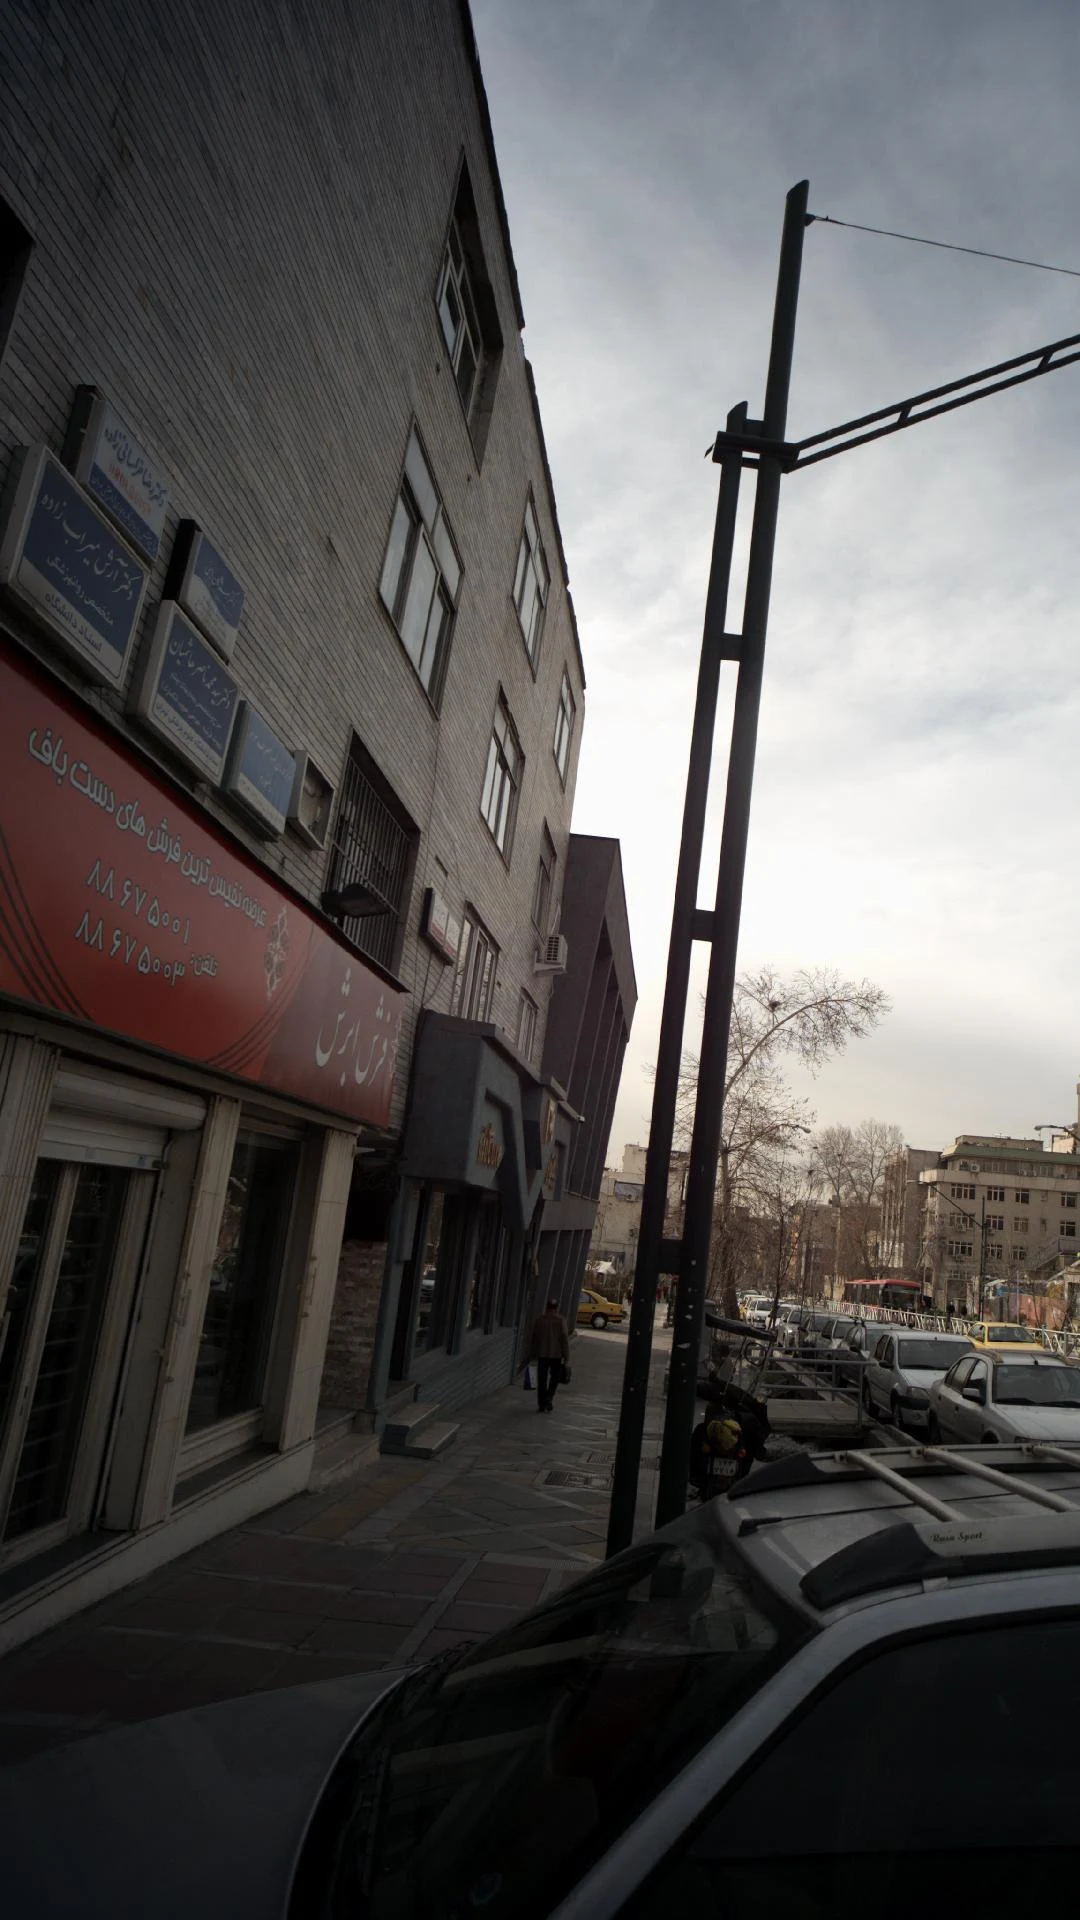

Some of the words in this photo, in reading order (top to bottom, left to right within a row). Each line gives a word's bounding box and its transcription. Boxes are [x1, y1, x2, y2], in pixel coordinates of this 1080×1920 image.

[41, 494, 67, 520] زاده
[93, 548, 128, 582] آرش
[112, 570, 142, 601] دکتر
[28, 727, 68, 785] باف
[69, 760, 116, 814] دست
[116, 799, 146, 838] های
[147, 817, 181, 864] فرش
[180, 849, 212, 886] ترین
[208, 876, 243, 908] نفیس
[241, 896, 267, 928] عرضه
[355, 992, 391, 1088] فرش
